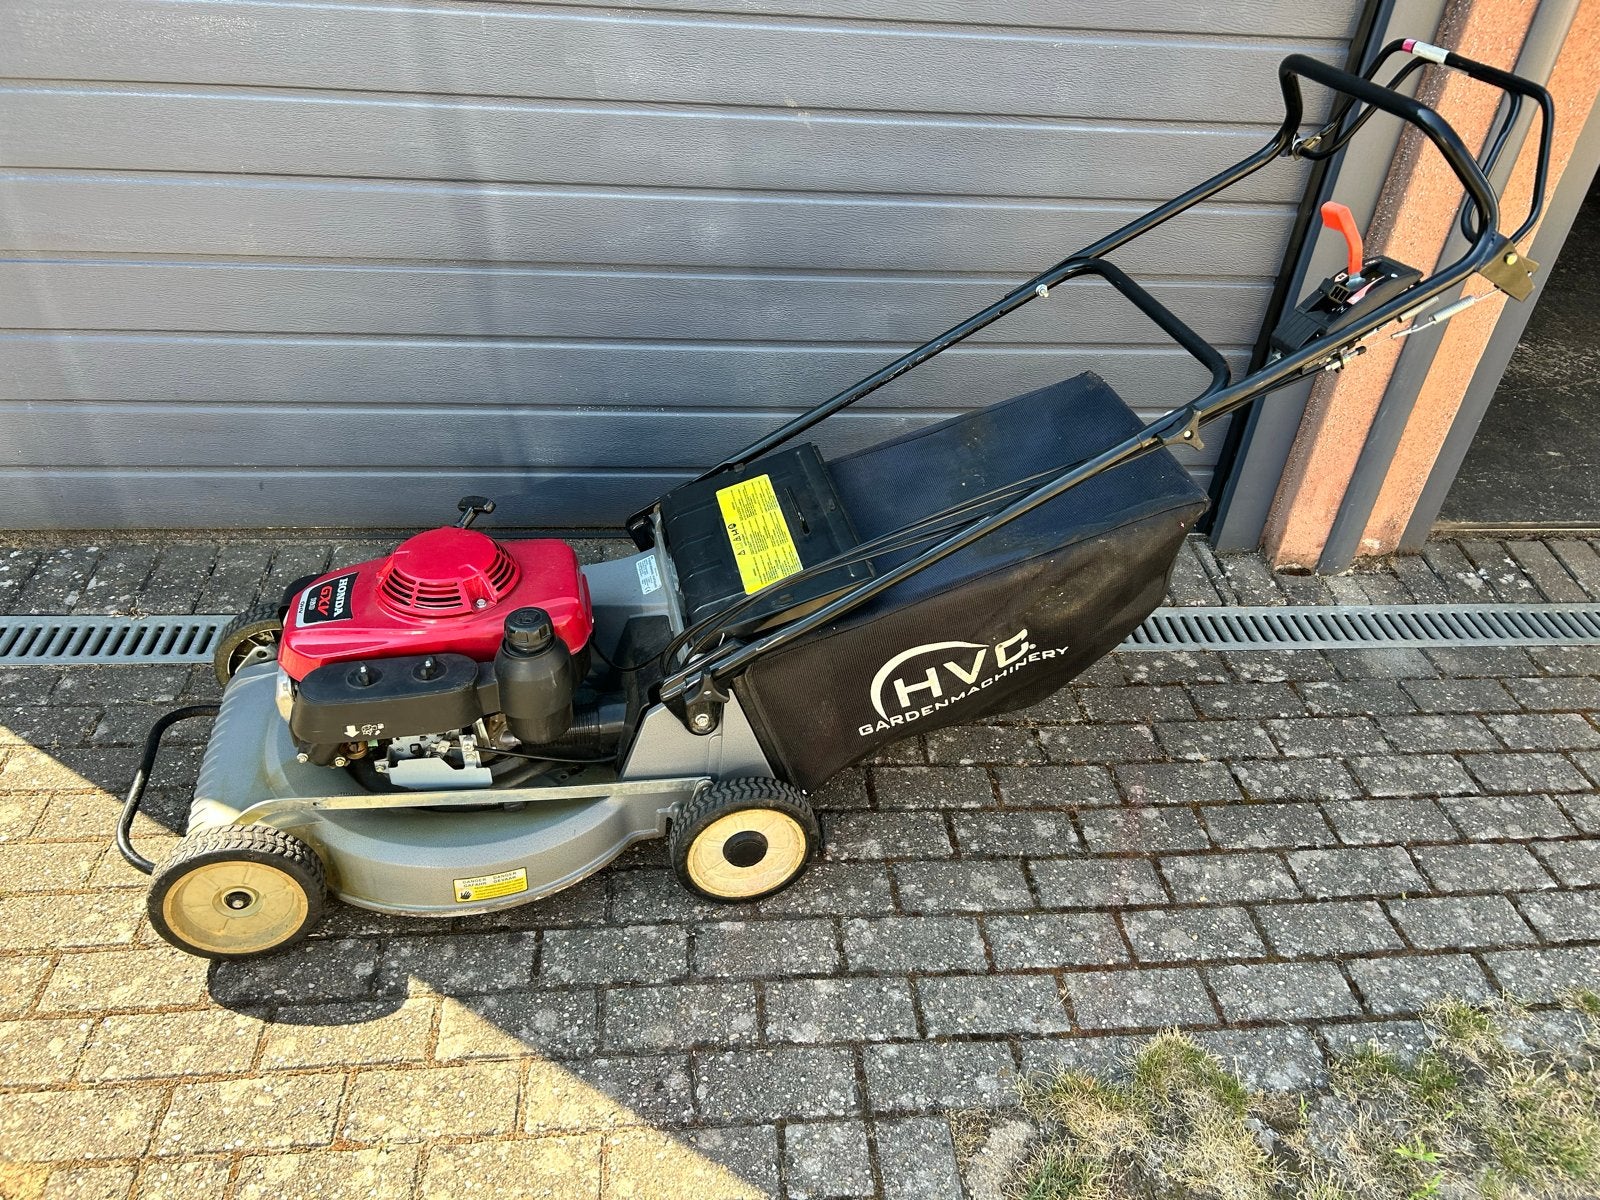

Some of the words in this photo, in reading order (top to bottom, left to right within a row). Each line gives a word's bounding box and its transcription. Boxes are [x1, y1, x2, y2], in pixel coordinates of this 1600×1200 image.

[317, 585, 333, 616] GXV
[333, 577, 349, 617] HONDA
[858, 646, 1069, 736] GARDENMACHINERY
